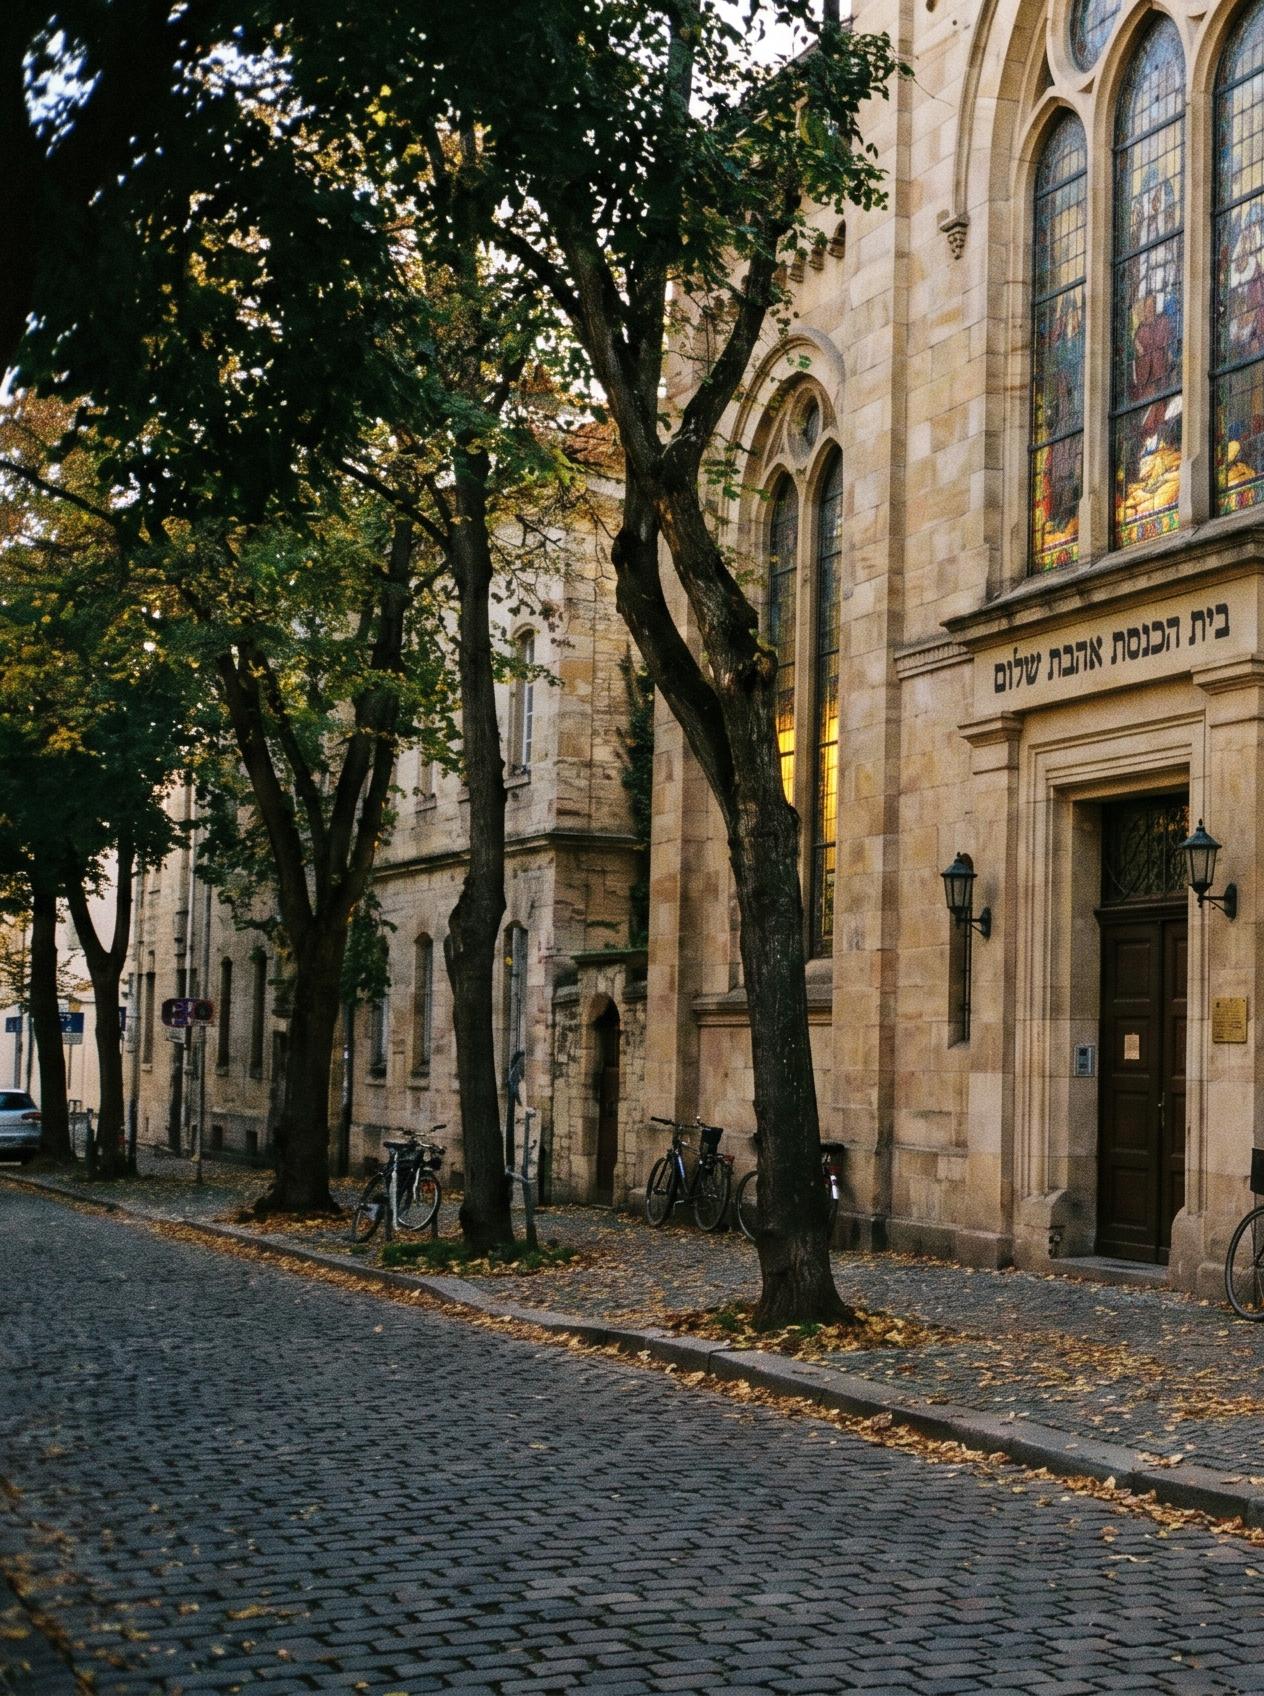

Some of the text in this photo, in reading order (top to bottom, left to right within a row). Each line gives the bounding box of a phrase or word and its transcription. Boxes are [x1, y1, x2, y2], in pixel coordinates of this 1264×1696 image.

[994, 602, 1230, 694] בית הכנסת אהבת שלום
